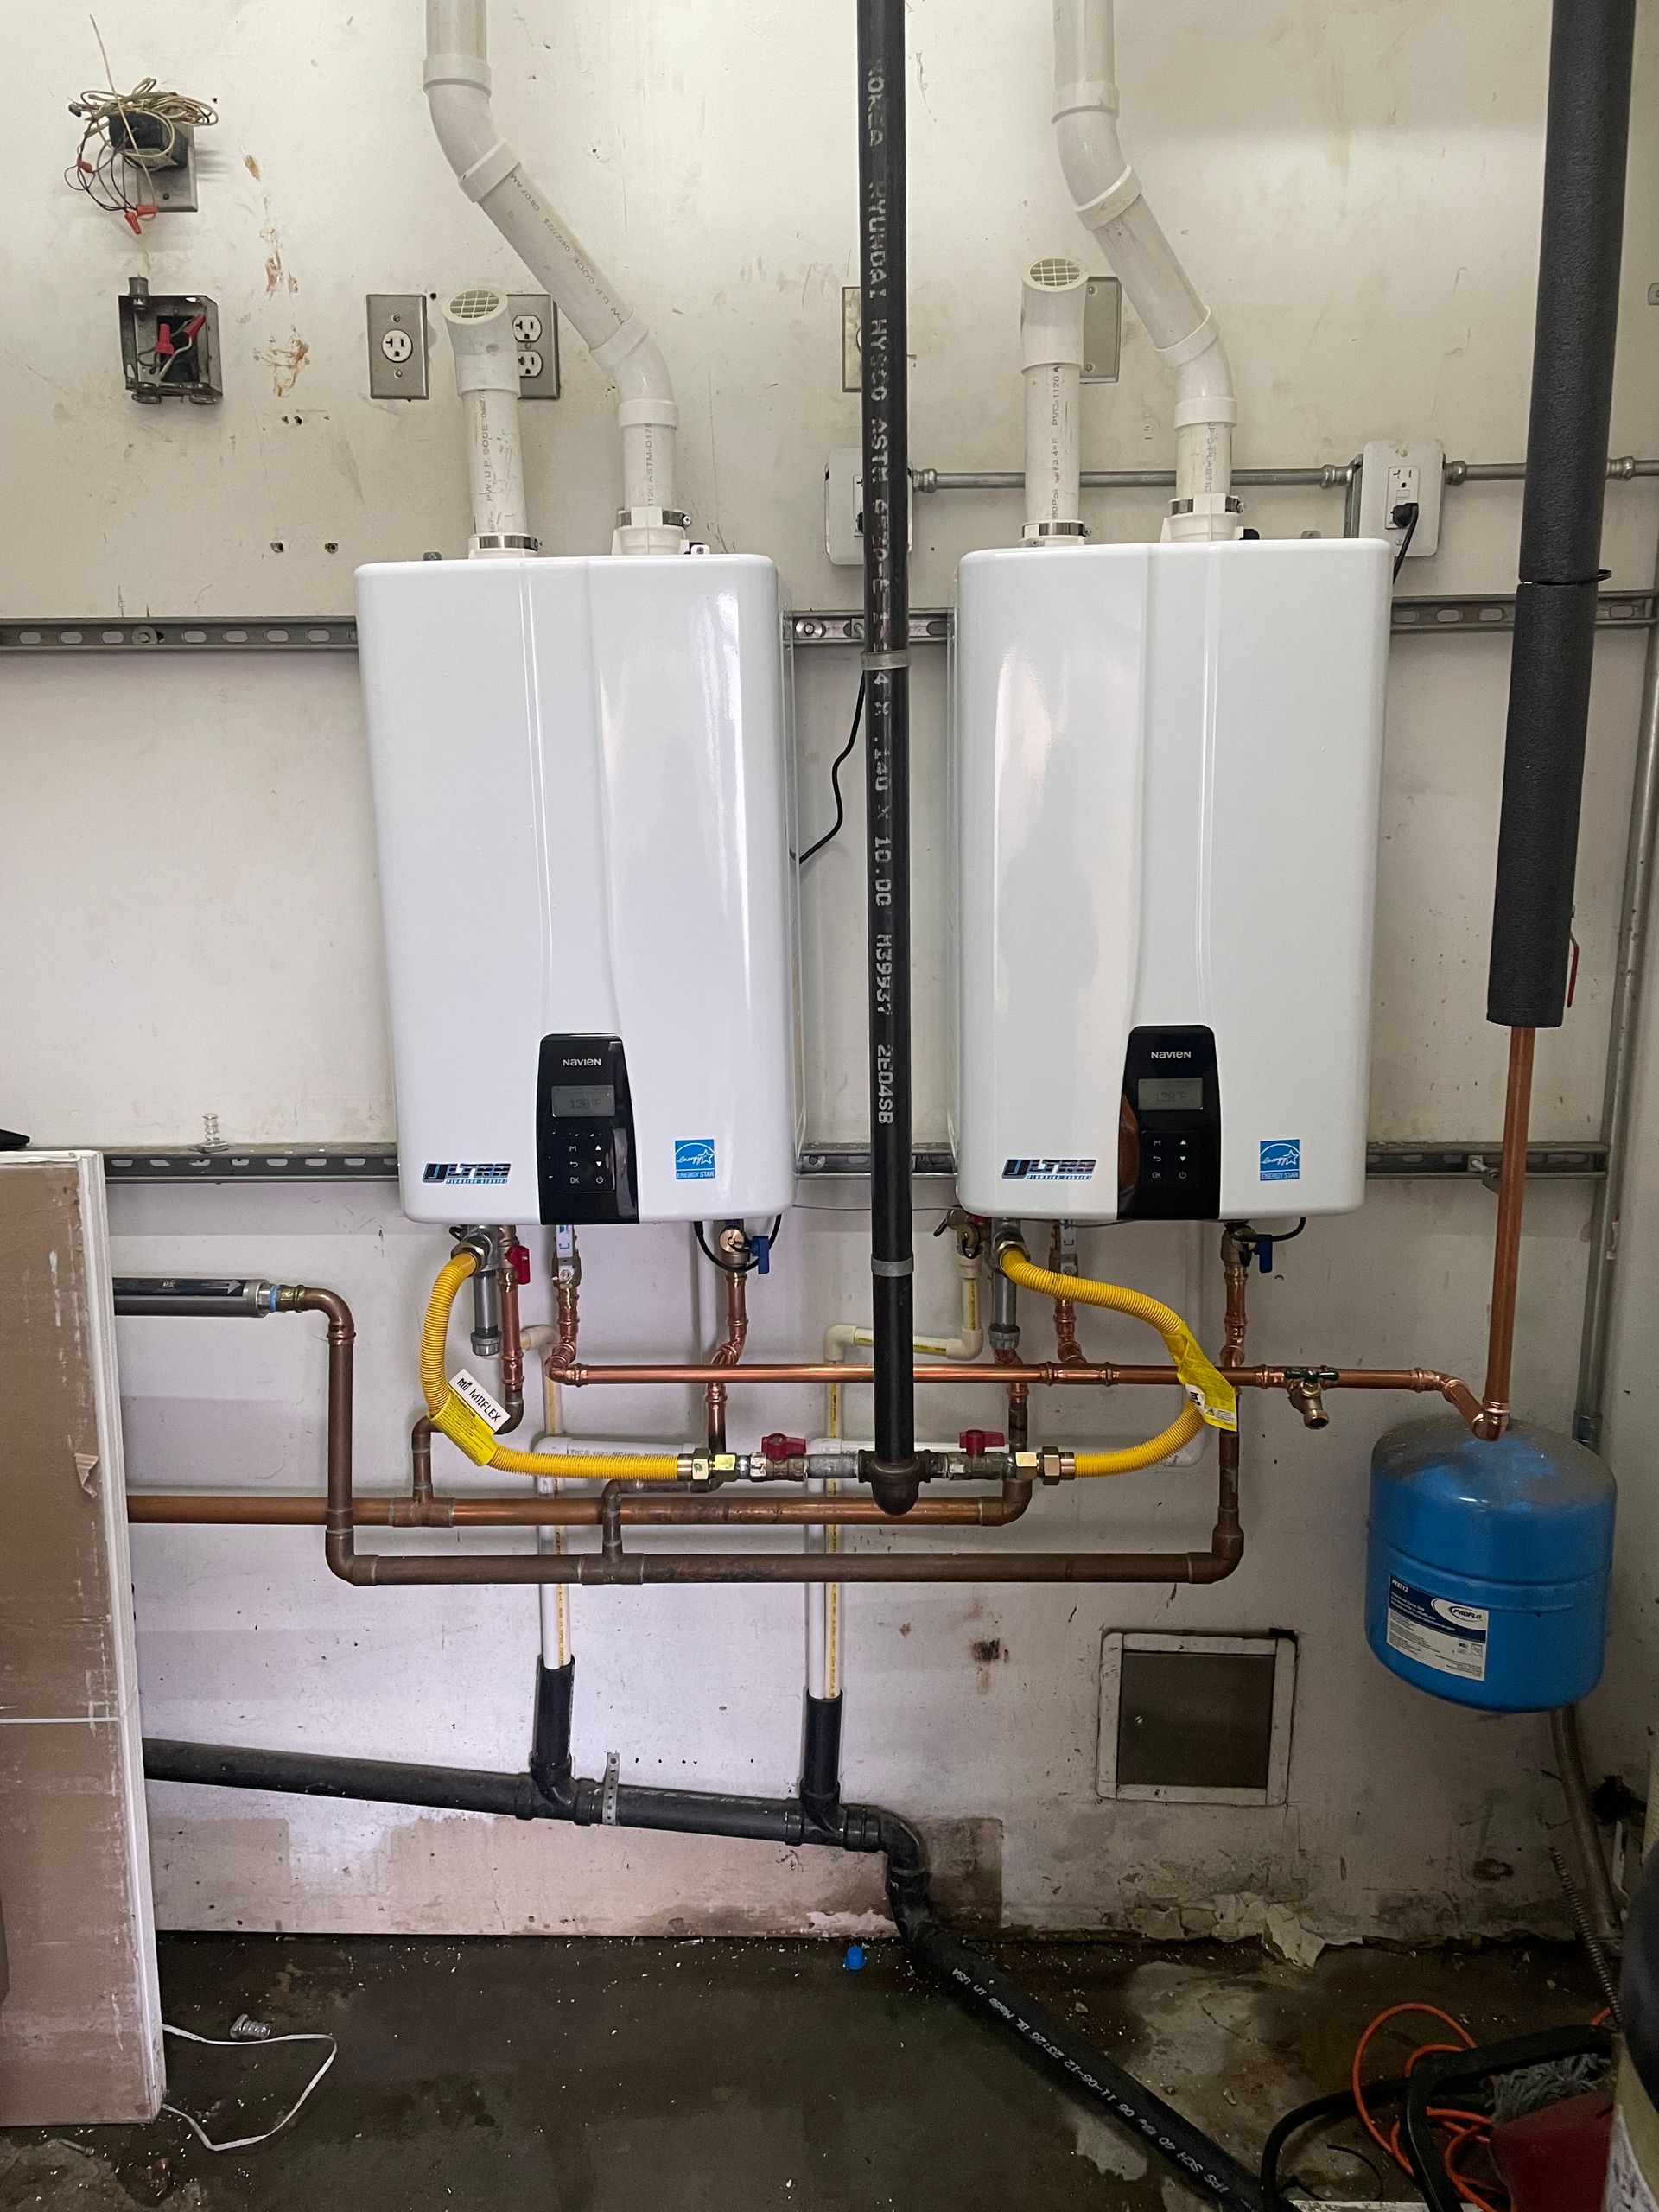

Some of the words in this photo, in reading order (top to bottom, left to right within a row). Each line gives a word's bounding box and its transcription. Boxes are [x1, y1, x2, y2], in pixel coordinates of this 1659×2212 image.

[875, 836, 892, 906] 10.00
[422, 1162, 511, 1183] ULTRA
[1001, 1159, 1096, 1179] ULTRA
[468, 1389, 502, 1422] MIIFLEX
[1452, 1608, 1482, 1620] PROFLO
[952, 1967, 972, 1985] USA
[973, 1984, 987, 1996] in
[988, 1997, 1015, 2019] Made
[1118, 2103, 1135, 2117] 06
[1176, 2151, 1204, 2173] SCH
